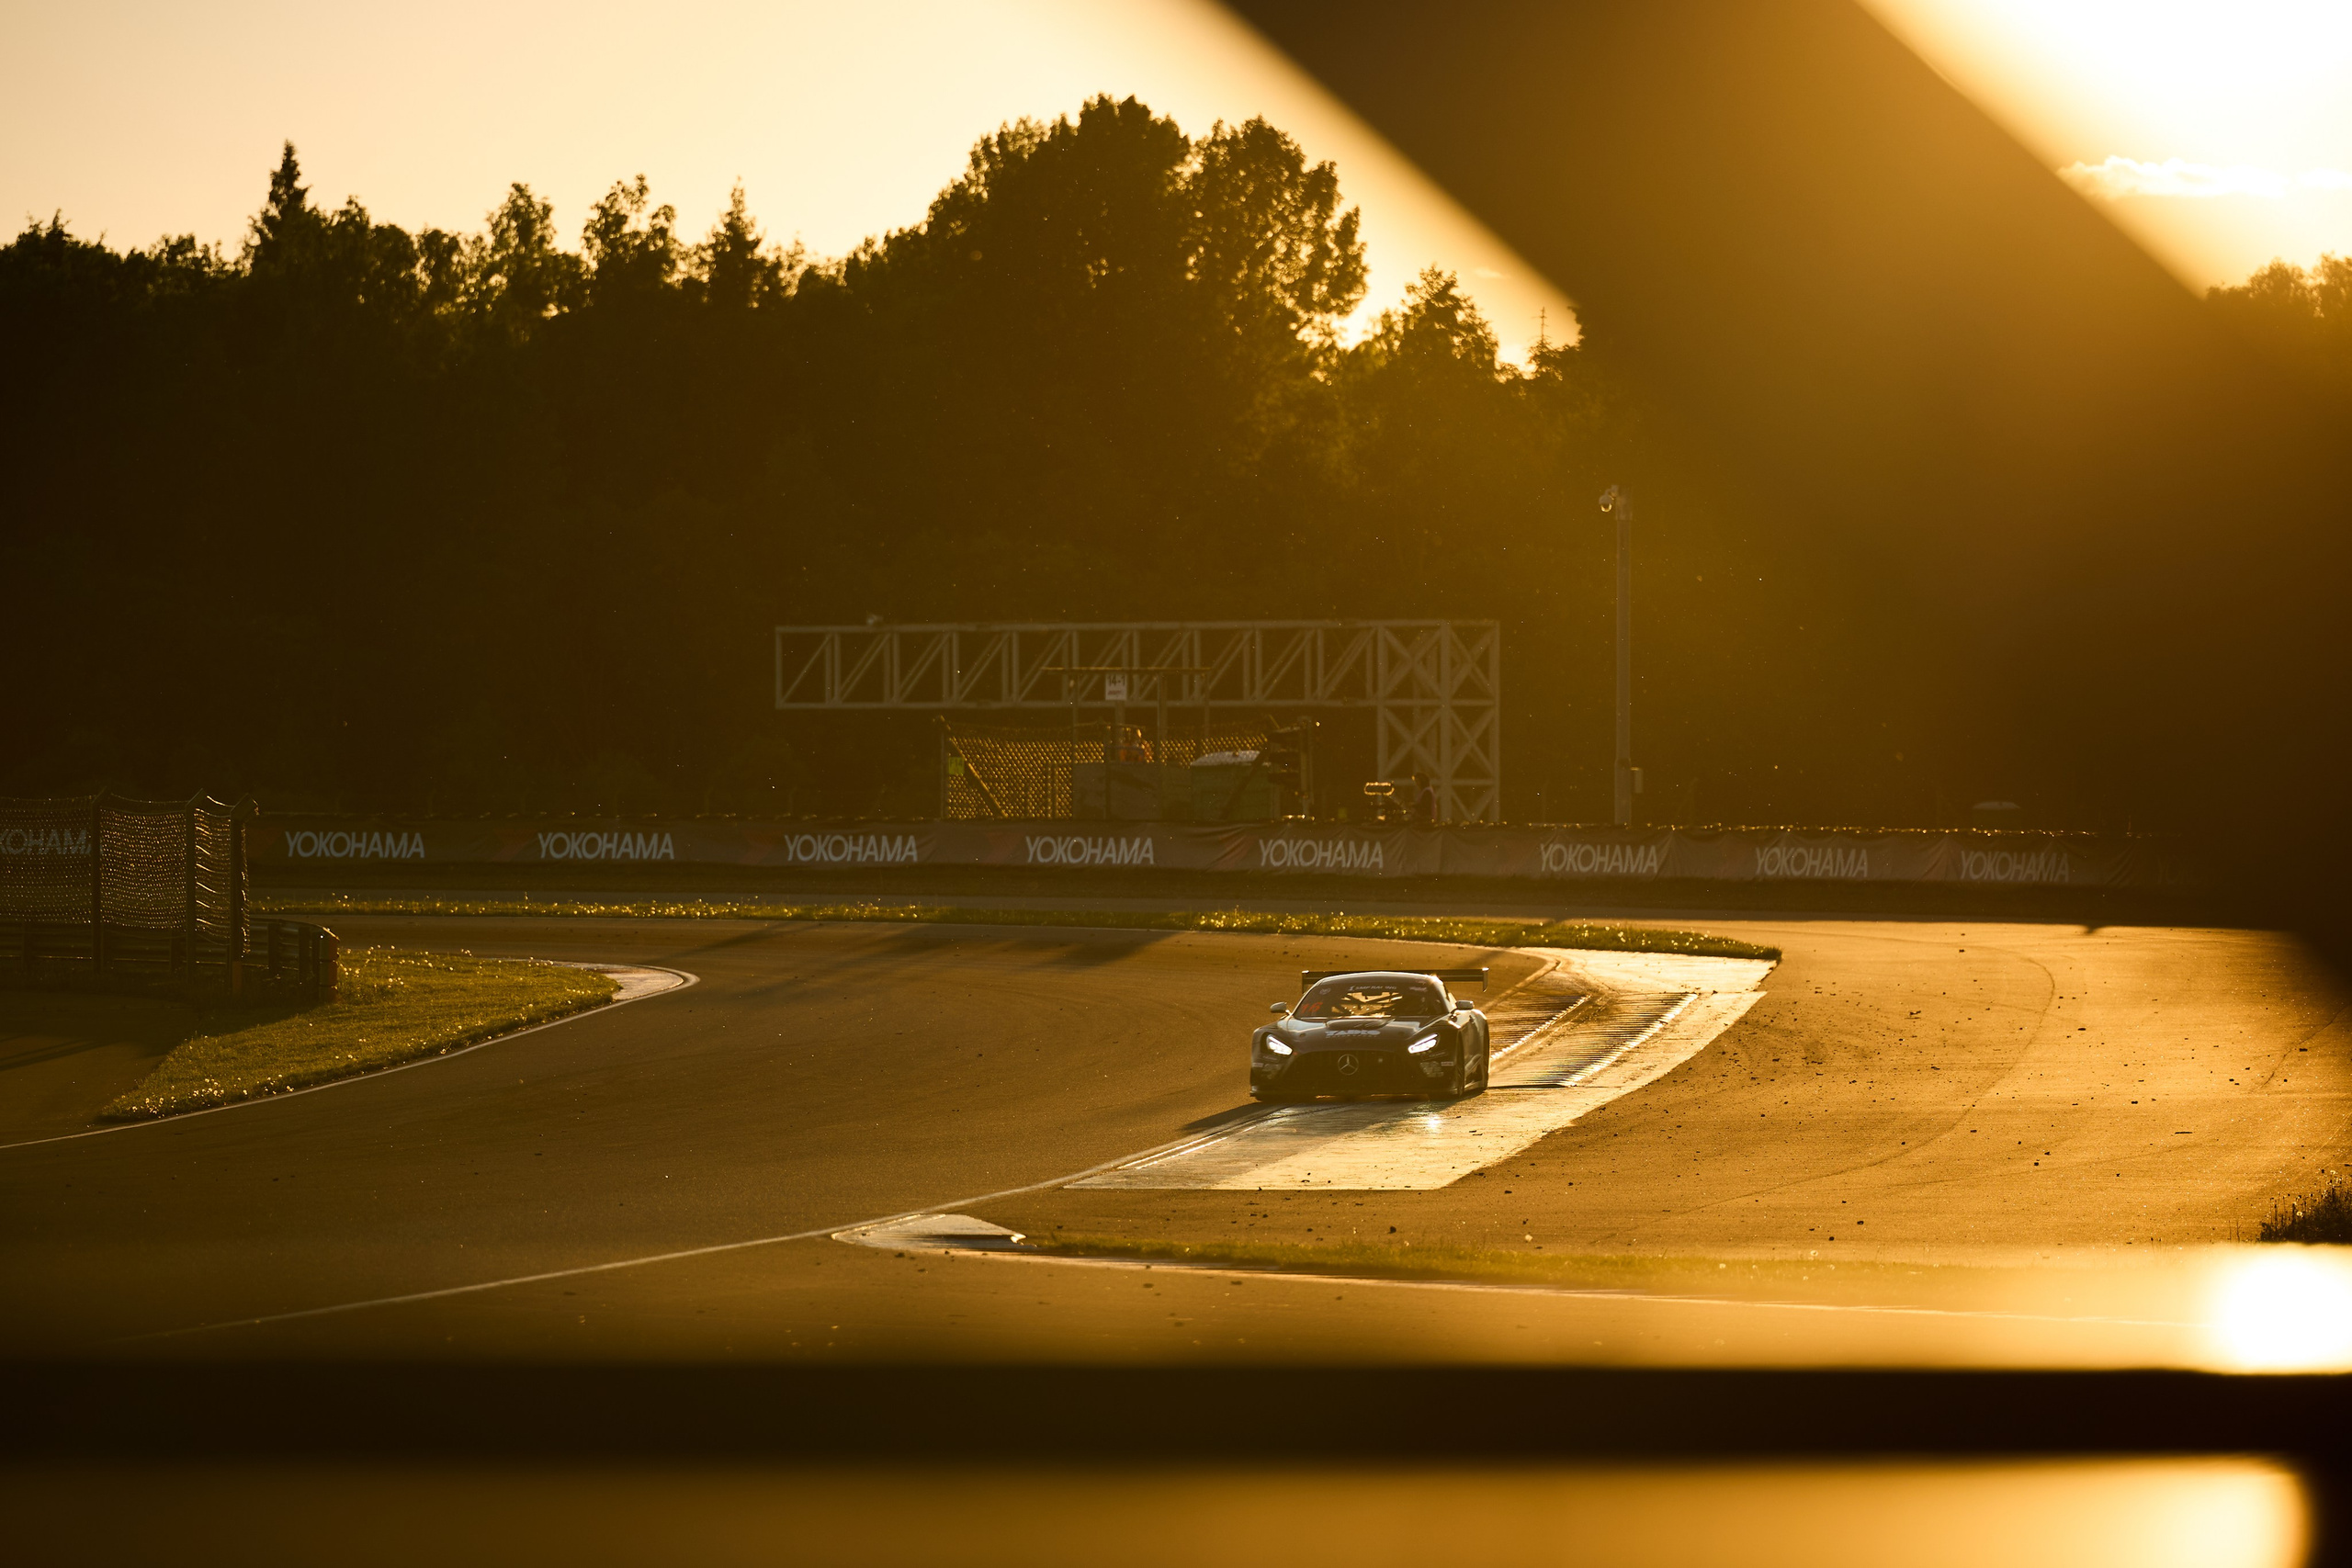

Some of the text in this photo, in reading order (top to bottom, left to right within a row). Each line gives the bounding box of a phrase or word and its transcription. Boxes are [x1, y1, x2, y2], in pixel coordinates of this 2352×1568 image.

[285, 830, 425, 858] YOKOHAMA
[537, 832, 674, 860] YOKOHAMA
[784, 834, 918, 863] YOKOHAMA
[1025, 836, 1154, 865] YOKOHAMA
[1259, 839, 1384, 869] YOKOHAMA
[1540, 843, 1657, 874] YOKOHAMA
[1756, 847, 1868, 877] YOKOHAMA
[1960, 851, 2069, 883] YOKOHAMA
[1301, 1001, 1323, 1014] 16
